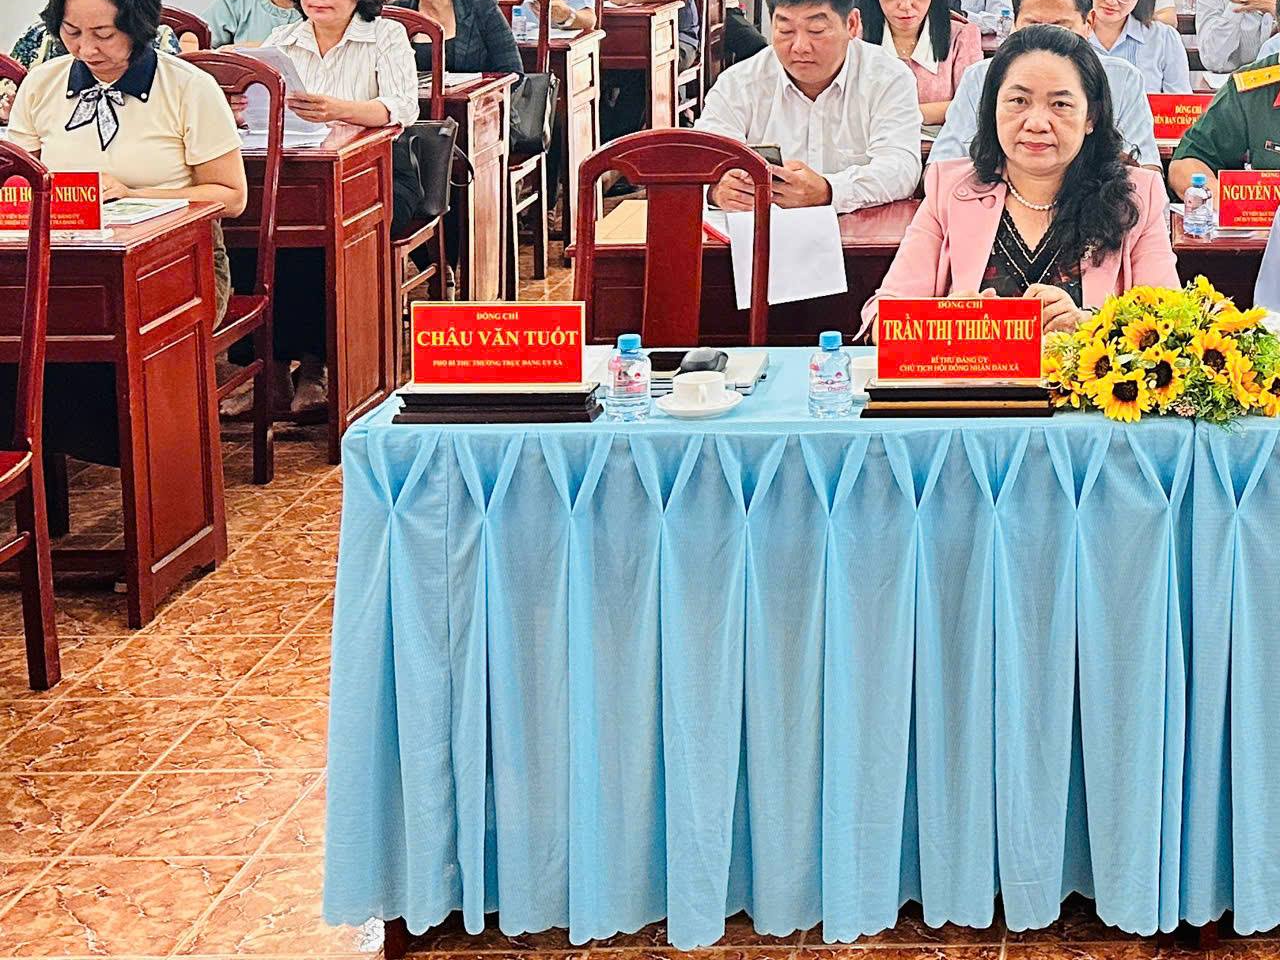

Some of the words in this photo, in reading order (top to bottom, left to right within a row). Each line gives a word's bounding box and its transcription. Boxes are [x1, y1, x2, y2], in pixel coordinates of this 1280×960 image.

[55, 186, 97, 202] NHUNG
[1223, 181, 1271, 201] NGUYỄN
[416, 327, 473, 346] CHÂU
[478, 327, 520, 346] VĂN
[883, 312, 923, 341] TRẦN
[927, 319, 953, 346] THỊ
[955, 313, 1002, 341] THIÊN
[1004, 316, 1037, 340] THƯ
